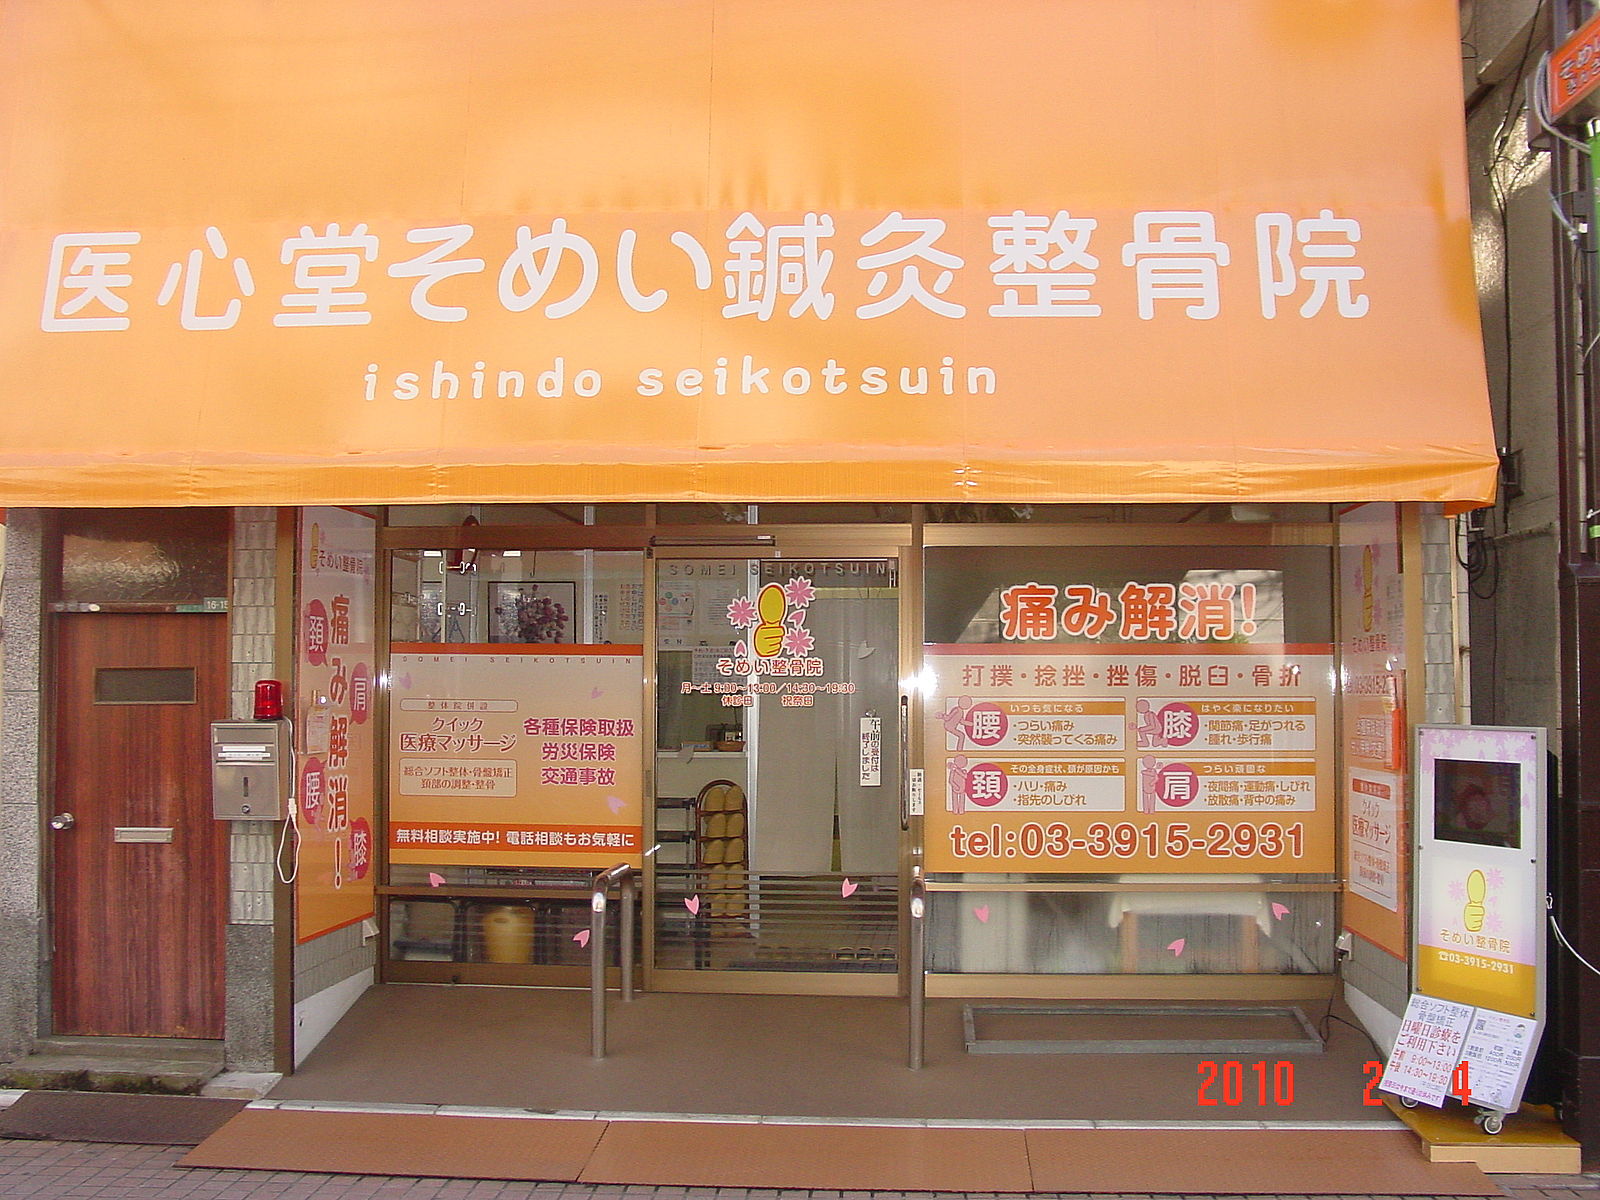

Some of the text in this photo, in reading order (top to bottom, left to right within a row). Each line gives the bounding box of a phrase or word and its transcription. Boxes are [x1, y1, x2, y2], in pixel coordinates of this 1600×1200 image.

[40, 208, 1370, 333] 医心堂そめい鍼灸整骨院
[364, 355, 997, 401] ishindo seikotsuin
[669, 562, 888, 578] SOMEI SEIKOTSUIN
[1000, 582, 1258, 641] 痛み解消!
[716, 657, 824, 677] そめい整骨院
[1009, 704, 1084, 713] いつも気になる
[432, 717, 484, 732] クイック
[523, 718, 635, 737] 各種保険取扱
[971, 710, 1001, 740] 腰
[1162, 709, 1193, 739] 膝
[400, 734, 517, 752] 医療マッサージ
[541, 742, 617, 761] 労災保険
[541, 767, 617, 786] 交通事故
[1162, 771, 1193, 800] 肩
[506, 831, 635, 847] 電話相談もお気軽に
[949, 822, 1304, 859] tel:03-3915-2931
[1439, 929, 1511, 954] そめい整骨院
